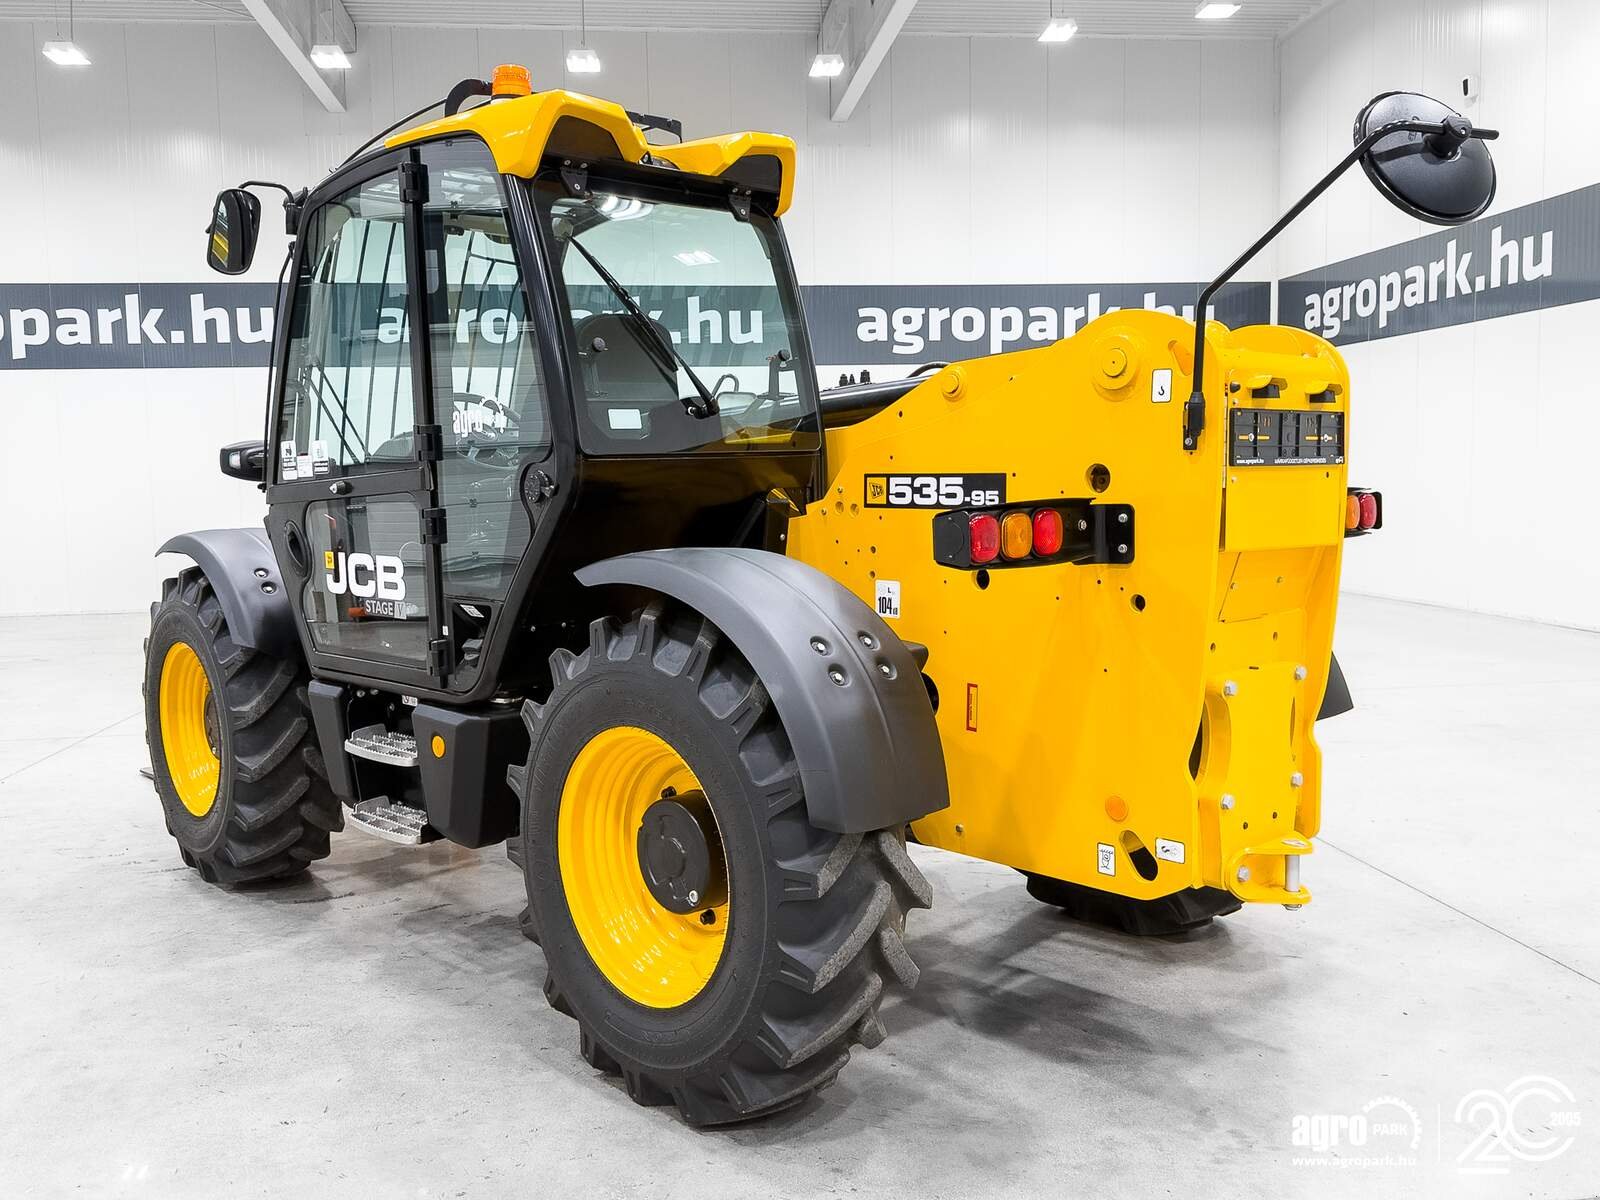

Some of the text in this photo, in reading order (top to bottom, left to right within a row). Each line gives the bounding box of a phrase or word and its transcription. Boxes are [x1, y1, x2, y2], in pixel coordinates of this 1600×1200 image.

[1304, 225, 1553, 339] agropark.hu
[0, 293, 274, 360] park.hu
[325, 551, 406, 601] JCB
[365, 599, 394, 616] STAGE
[878, 596, 893, 615] 104
